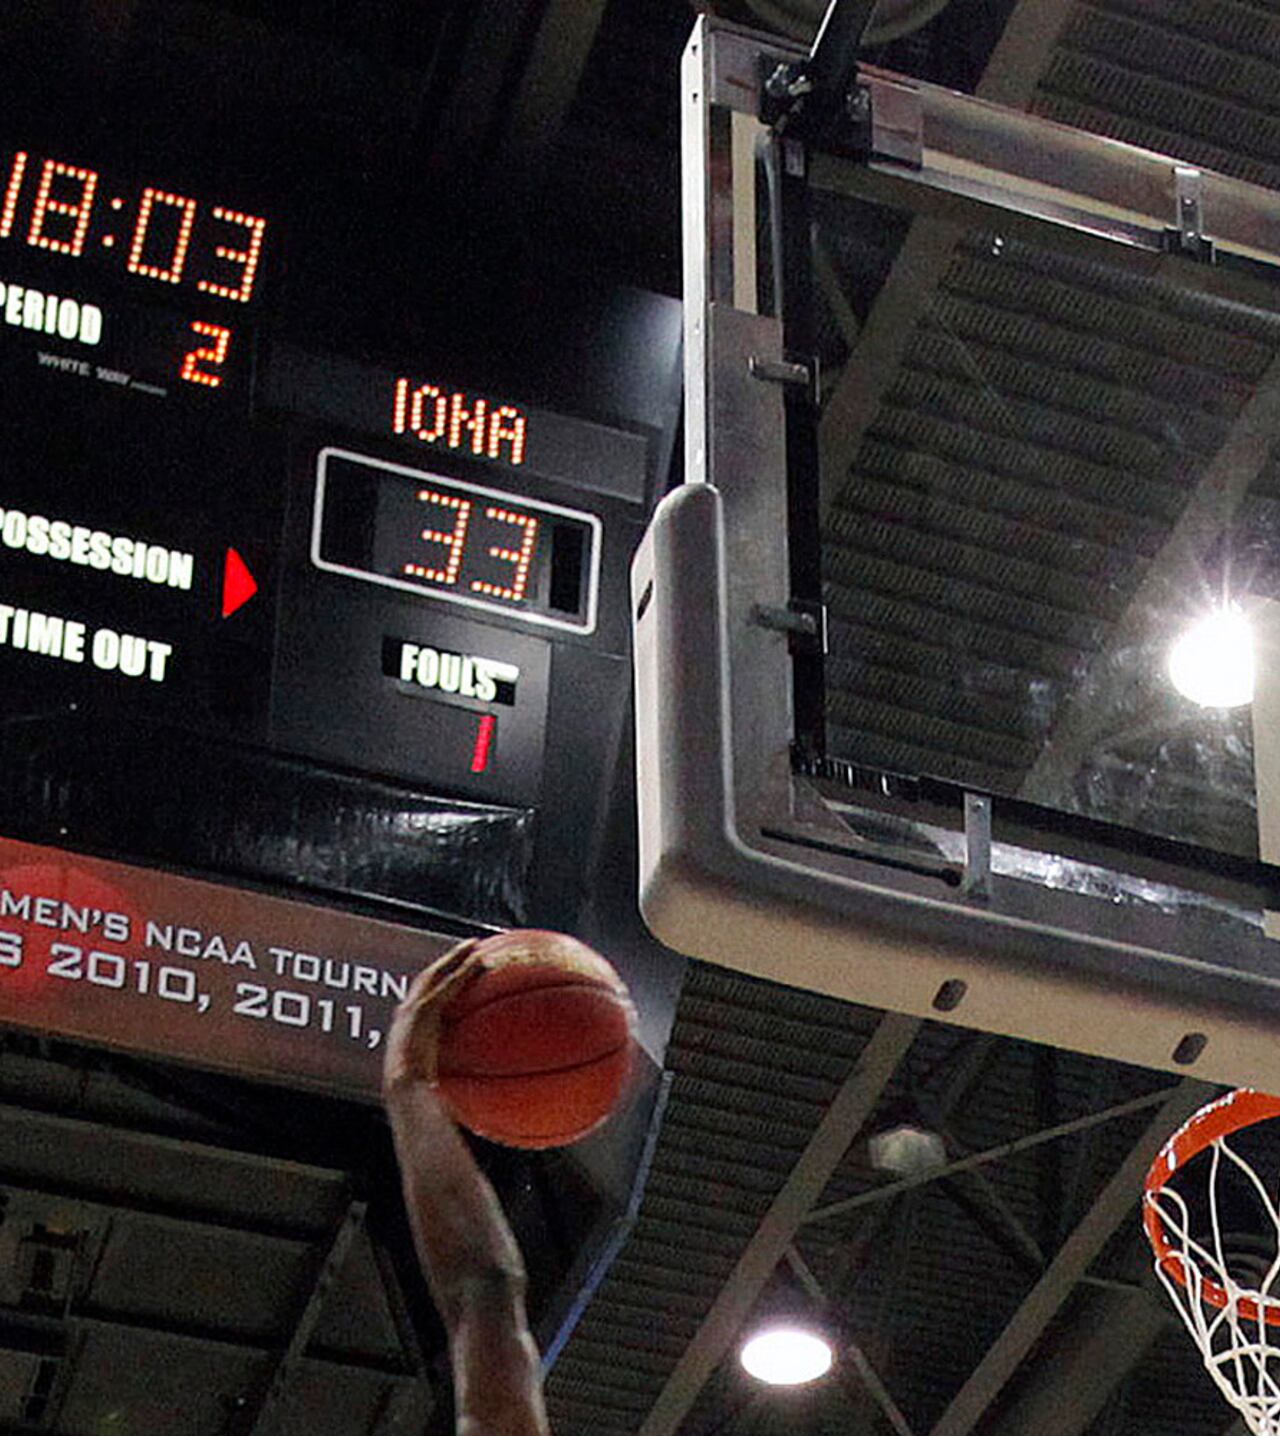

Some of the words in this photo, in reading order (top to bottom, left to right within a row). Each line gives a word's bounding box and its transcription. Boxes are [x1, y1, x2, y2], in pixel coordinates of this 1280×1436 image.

[180, 320, 232, 388] 2
[391, 377, 526, 465] IONA
[404, 490, 539, 601] 33
[91, 629, 172, 683] OUT
[399, 643, 500, 702] FOULS
[471, 714, 496, 773] 1
[143, 921, 256, 971] NCAA
[45, 940, 212, 1013] 2010,
[232, 981, 385, 1052] 2011,
